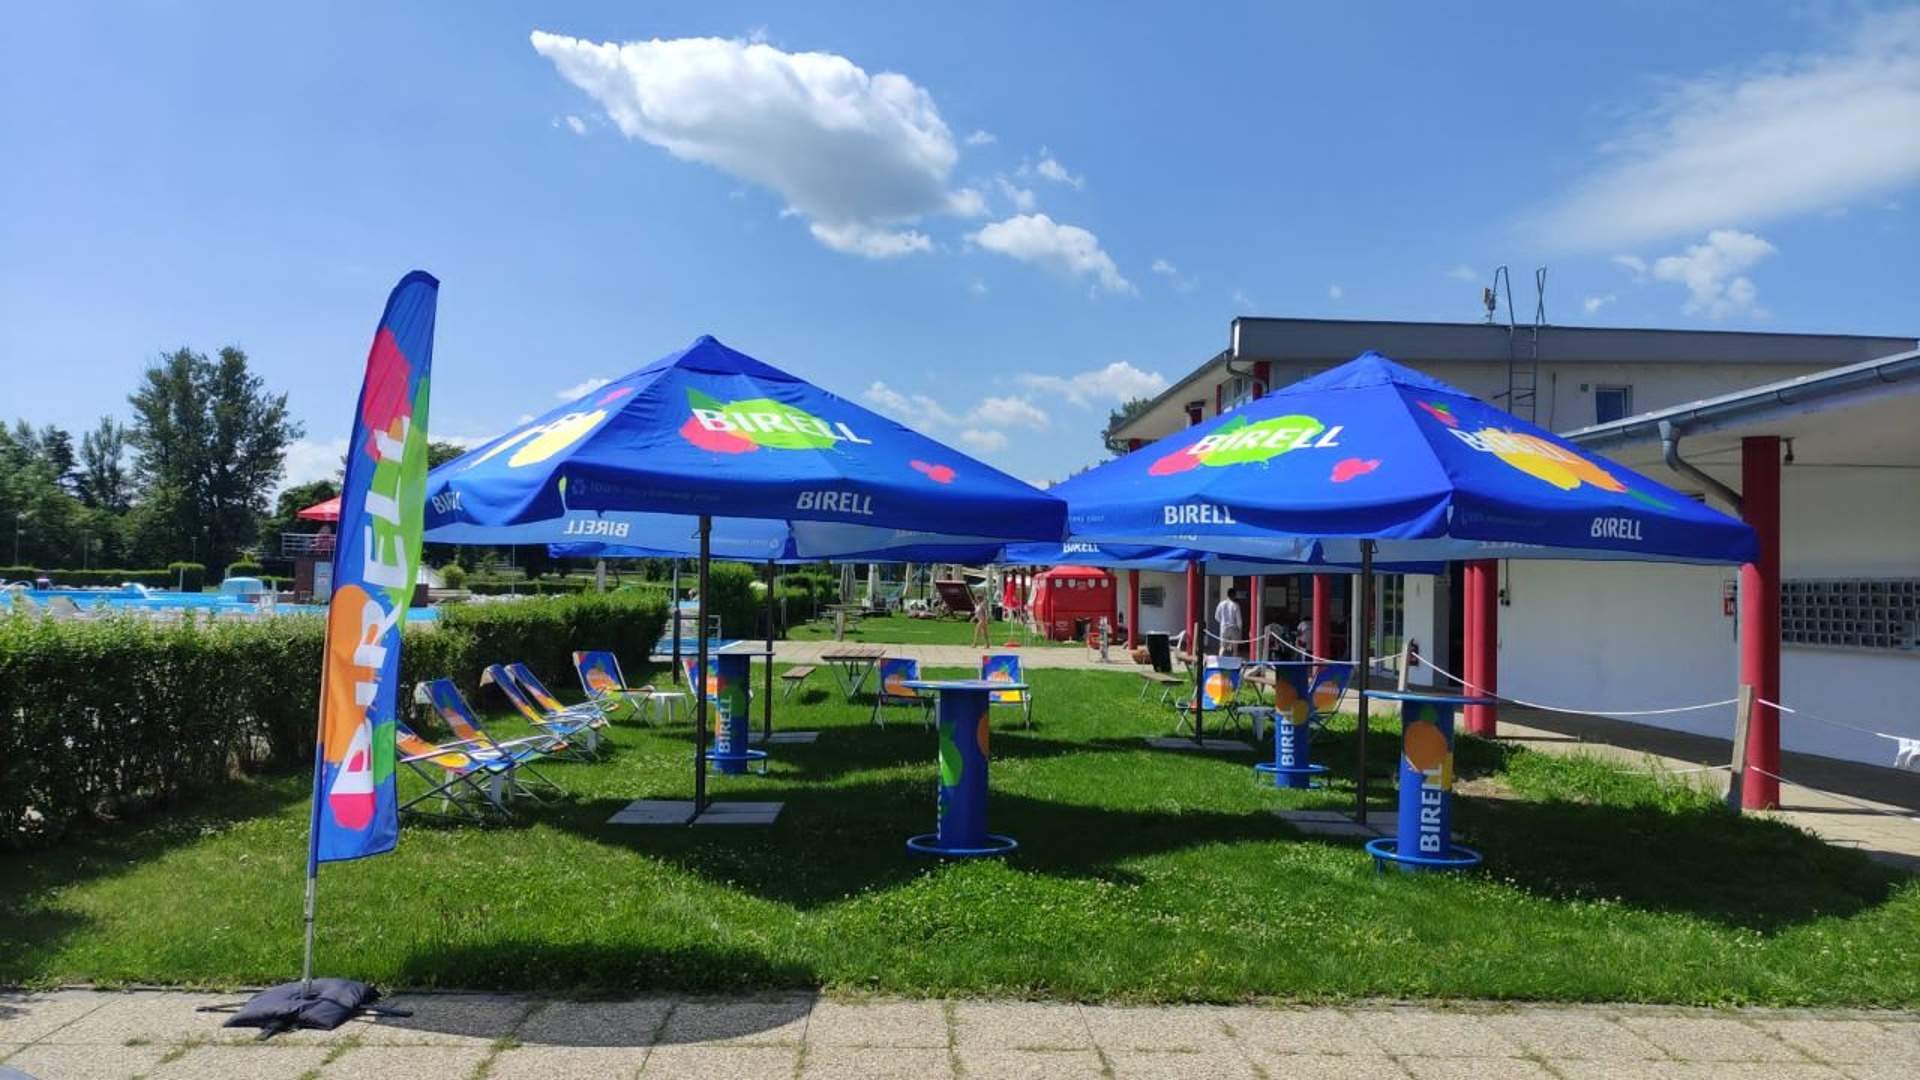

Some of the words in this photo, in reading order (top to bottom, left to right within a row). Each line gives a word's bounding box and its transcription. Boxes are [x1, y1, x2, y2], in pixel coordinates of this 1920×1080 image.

[692, 408, 872, 445] BIRELL
[1188, 425, 1344, 455] BIRELL
[796, 491, 874, 515] BIRELL
[1163, 504, 1237, 525] BIRELL
[1590, 517, 1643, 541] BIRELL
[1419, 763, 1442, 852] BIRELL
